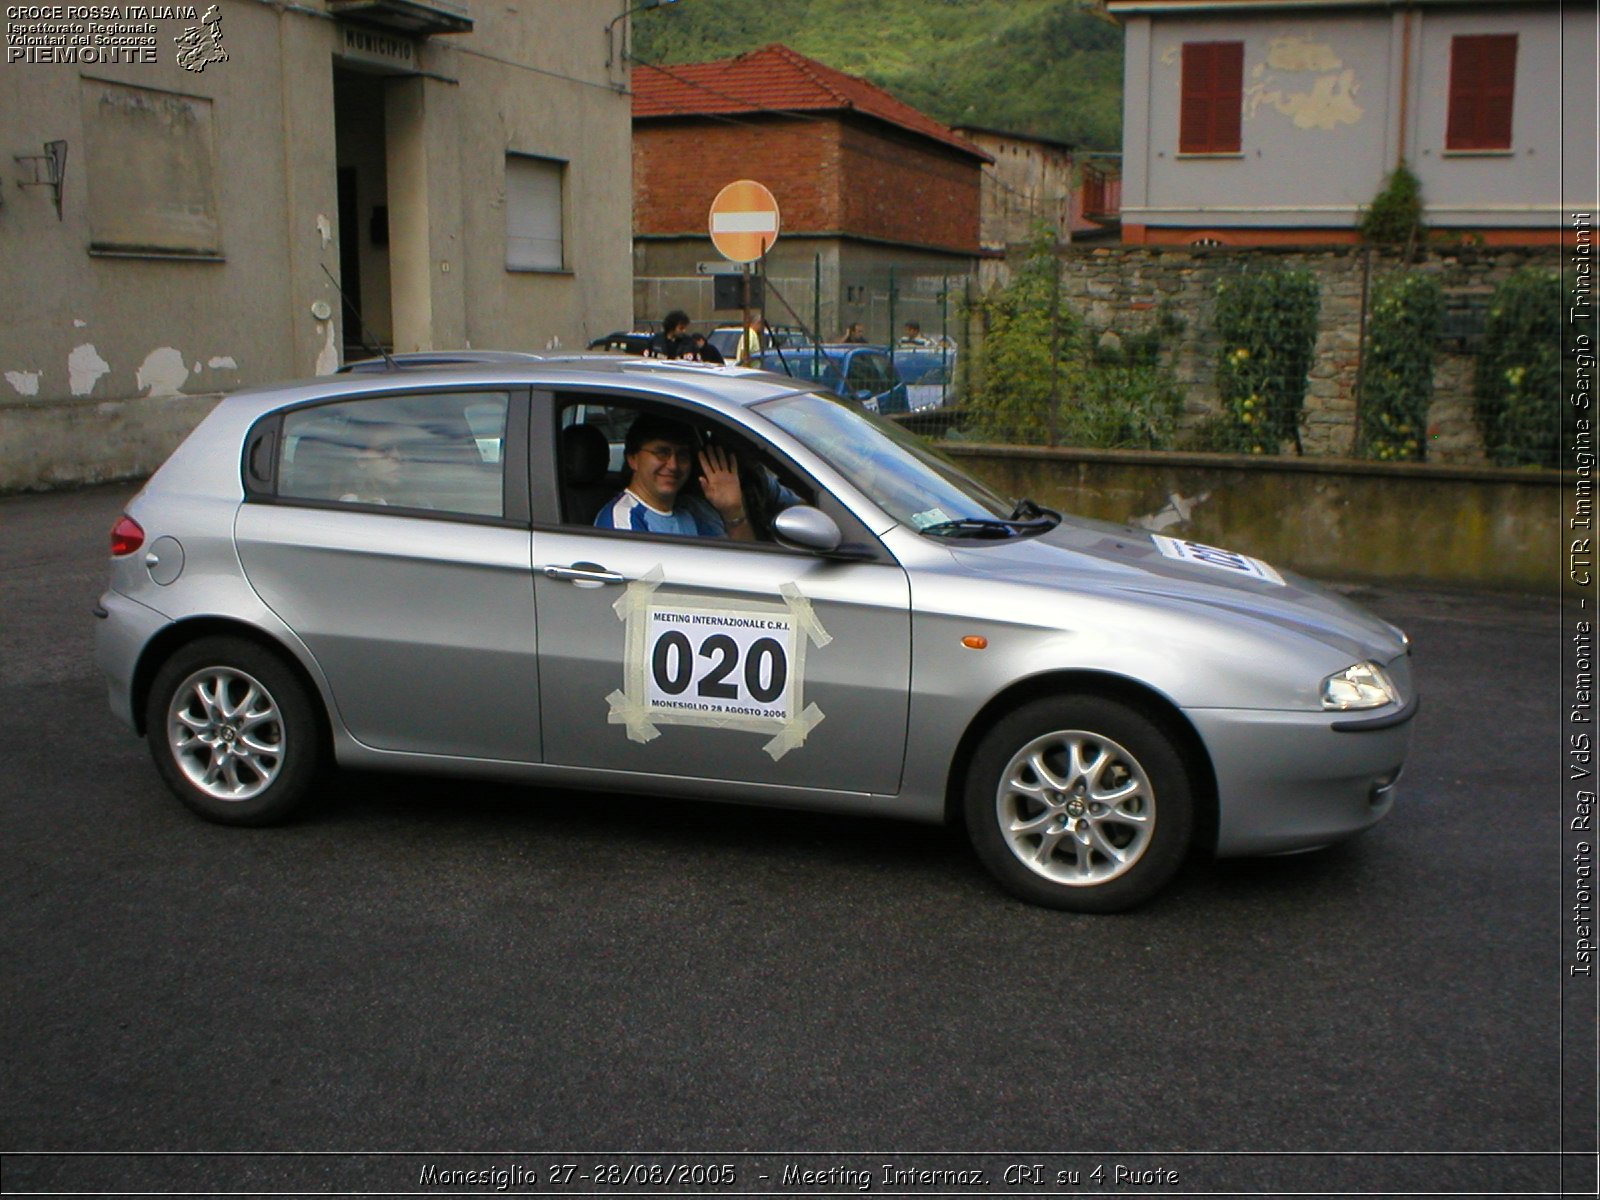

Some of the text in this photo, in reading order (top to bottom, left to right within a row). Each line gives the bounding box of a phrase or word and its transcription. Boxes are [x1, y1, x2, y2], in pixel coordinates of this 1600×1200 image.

[345, 29, 412, 60] MUNICIPIO
[653, 612, 790, 631] MEETING INTERNAZIONALE C.R.I.
[652, 630, 788, 704] 020
[651, 699, 709, 712] MONESIGLIO
[711, 704, 723, 713] 28
[725, 706, 761, 716] AGOSTO
